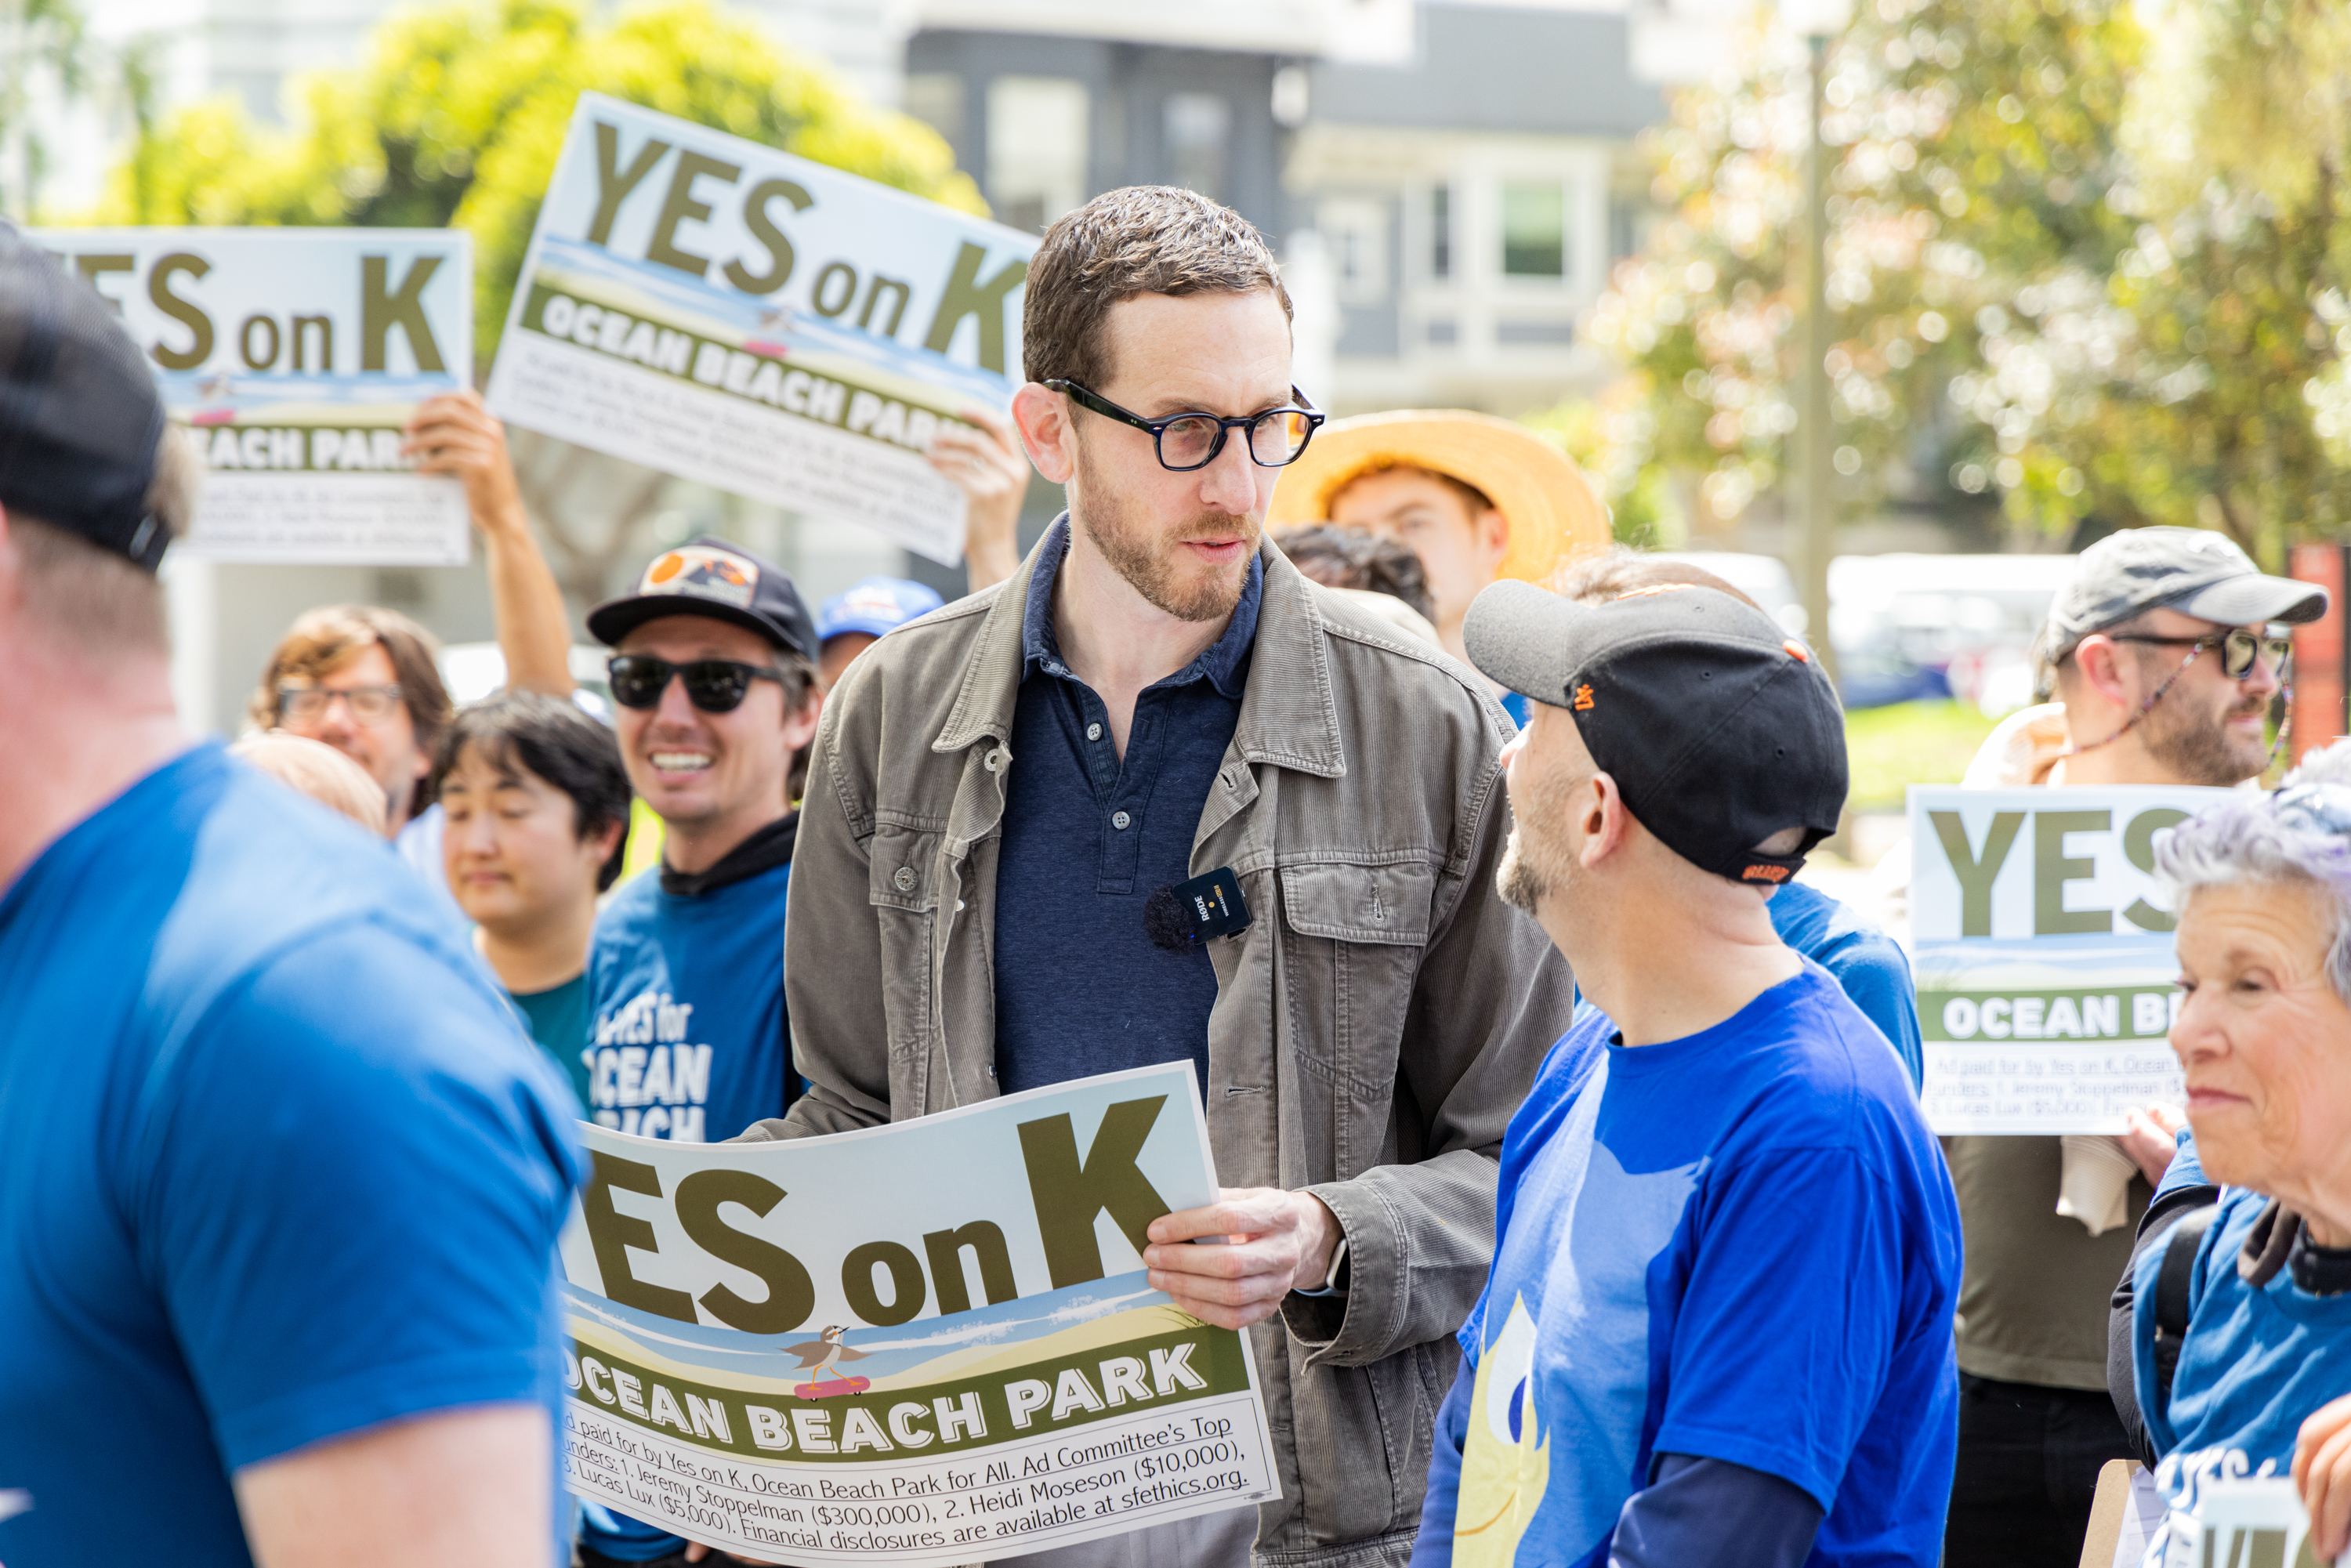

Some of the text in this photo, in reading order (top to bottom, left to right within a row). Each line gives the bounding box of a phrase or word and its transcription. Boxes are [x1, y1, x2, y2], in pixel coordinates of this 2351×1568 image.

[582, 121, 1028, 376] YES on K
[237, 312, 333, 371] on
[360, 255, 448, 372] K
[542, 293, 694, 378] OCEAN
[691, 334, 845, 428] BEACH
[845, 387, 989, 454] PAR
[188, 427, 415, 471] EACH PAR
[1194, 895, 1210, 922] RØDE
[1219, 896, 1229, 917] WIRELESS
[1927, 807, 2194, 940] YES
[1943, 993, 2121, 1041] OCEAN
[578, 1094, 1197, 1334] ES on K
[744, 1391, 988, 1454] BEACH
[1004, 1342, 1208, 1430] PARK
[563, 1438, 1246, 1528] unders: 1. Jeremy Stoppelman ($300,000), 2. Heidi Moseson ($10,000),
[580, 1421, 613, 1446] paid
[616, 1432, 638, 1457] for
[642, 1442, 662, 1469] by
[665, 1450, 697, 1476] Yes
[701, 1466, 724, 1485] on
[730, 1468, 748, 1492] K,
[752, 1474, 813, 1497] Ocean
[822, 1478, 886, 1500] Beach
[892, 1473, 941, 1497] Park
[947, 1470, 976, 1489] for
[986, 1461, 1016, 1484] All.
[1023, 1454, 1051, 1476] Ad
[1057, 1424, 1185, 1468] Committee's
[1190, 1415, 1231, 1439] Top
[578, 1460, 624, 1494] Lucas
[626, 1480, 655, 1508] Lux
[658, 1492, 736, 1534] ($5,000).
[743, 1518, 824, 1548] Financial
[829, 1524, 946, 1550] disclosures
[953, 1526, 987, 1543] are
[995, 1502, 1087, 1535] available
[1094, 1495, 1115, 1514] at
[1121, 1468, 1248, 1509] sfethics.org.
